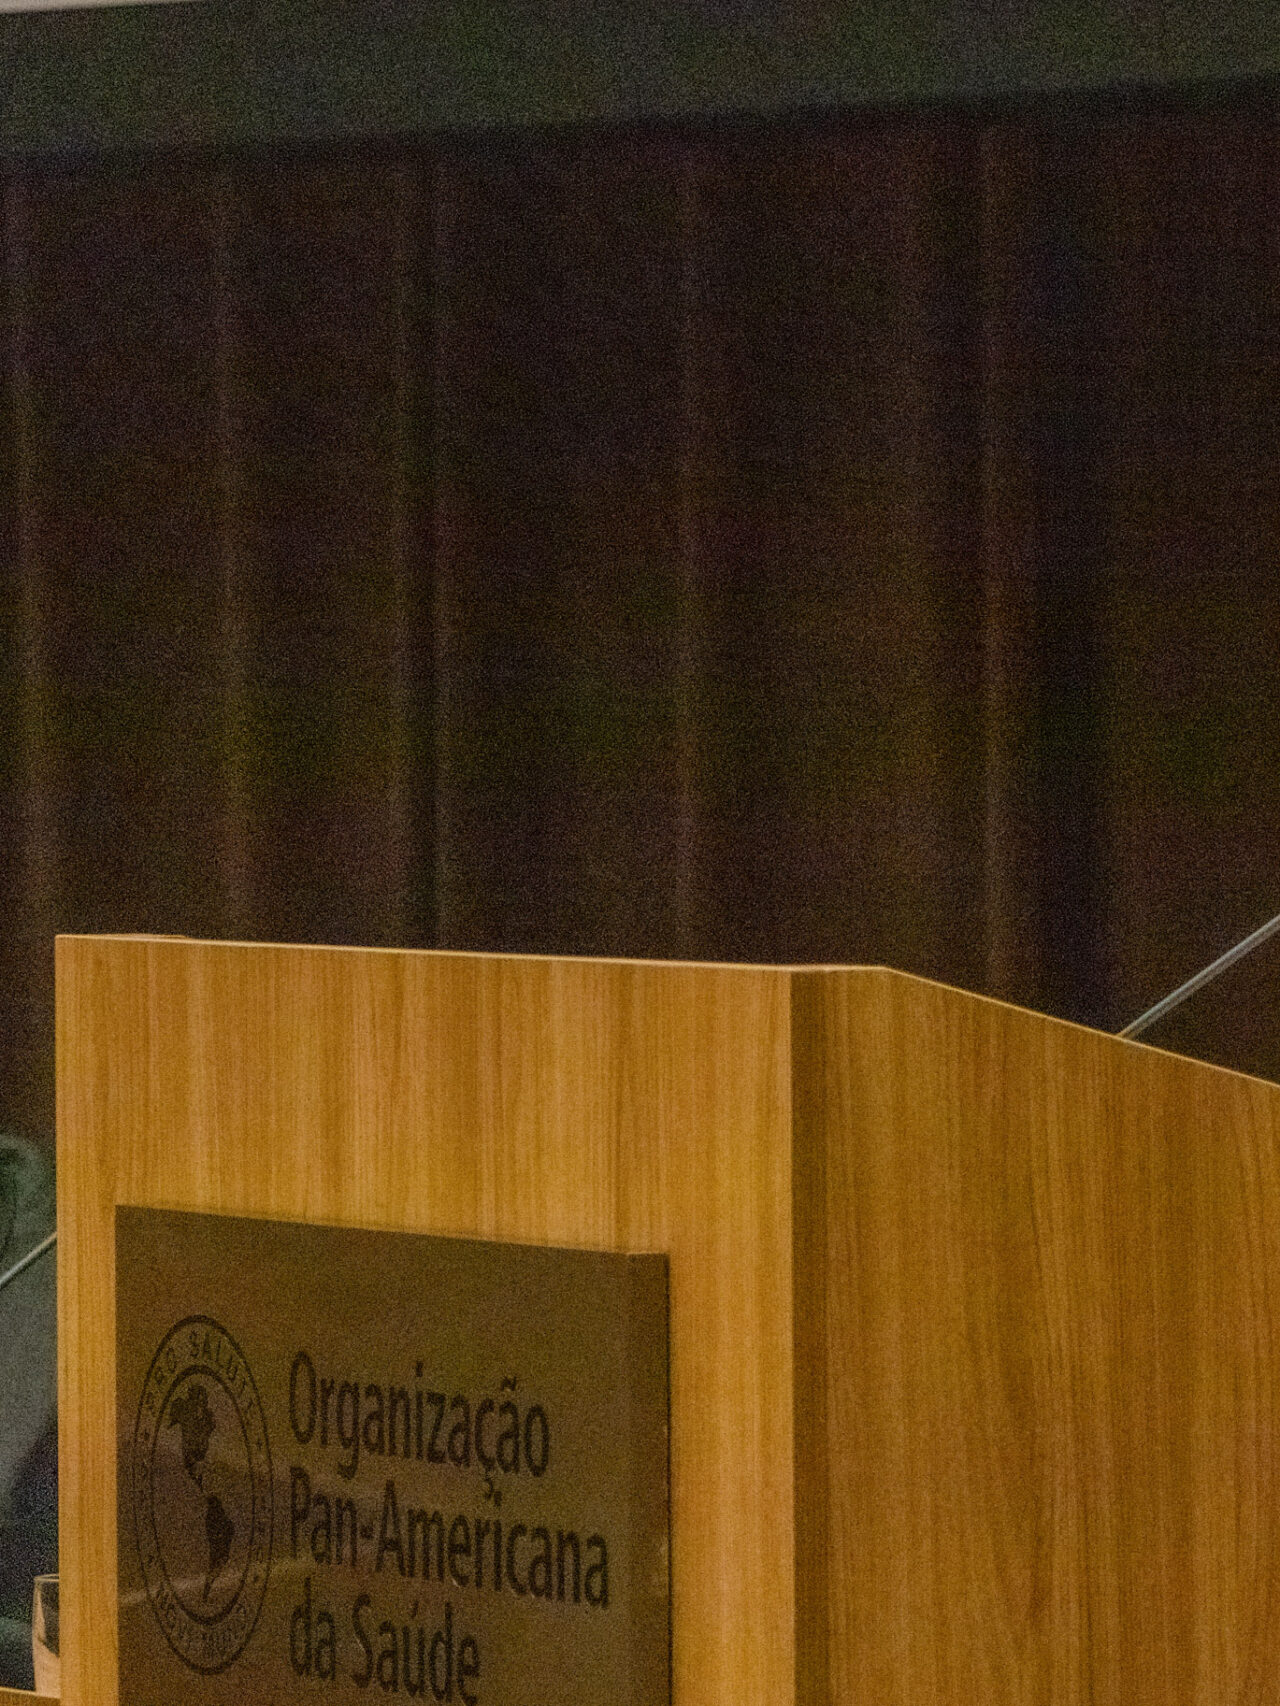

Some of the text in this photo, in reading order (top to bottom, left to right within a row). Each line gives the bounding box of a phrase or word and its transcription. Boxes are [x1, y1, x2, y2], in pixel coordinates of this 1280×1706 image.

[289, 1351, 551, 1495] Organização
[290, 1466, 610, 1610] Pan-Americana
[289, 1578, 336, 1682] da
[353, 1593, 481, 1705] Saúde
